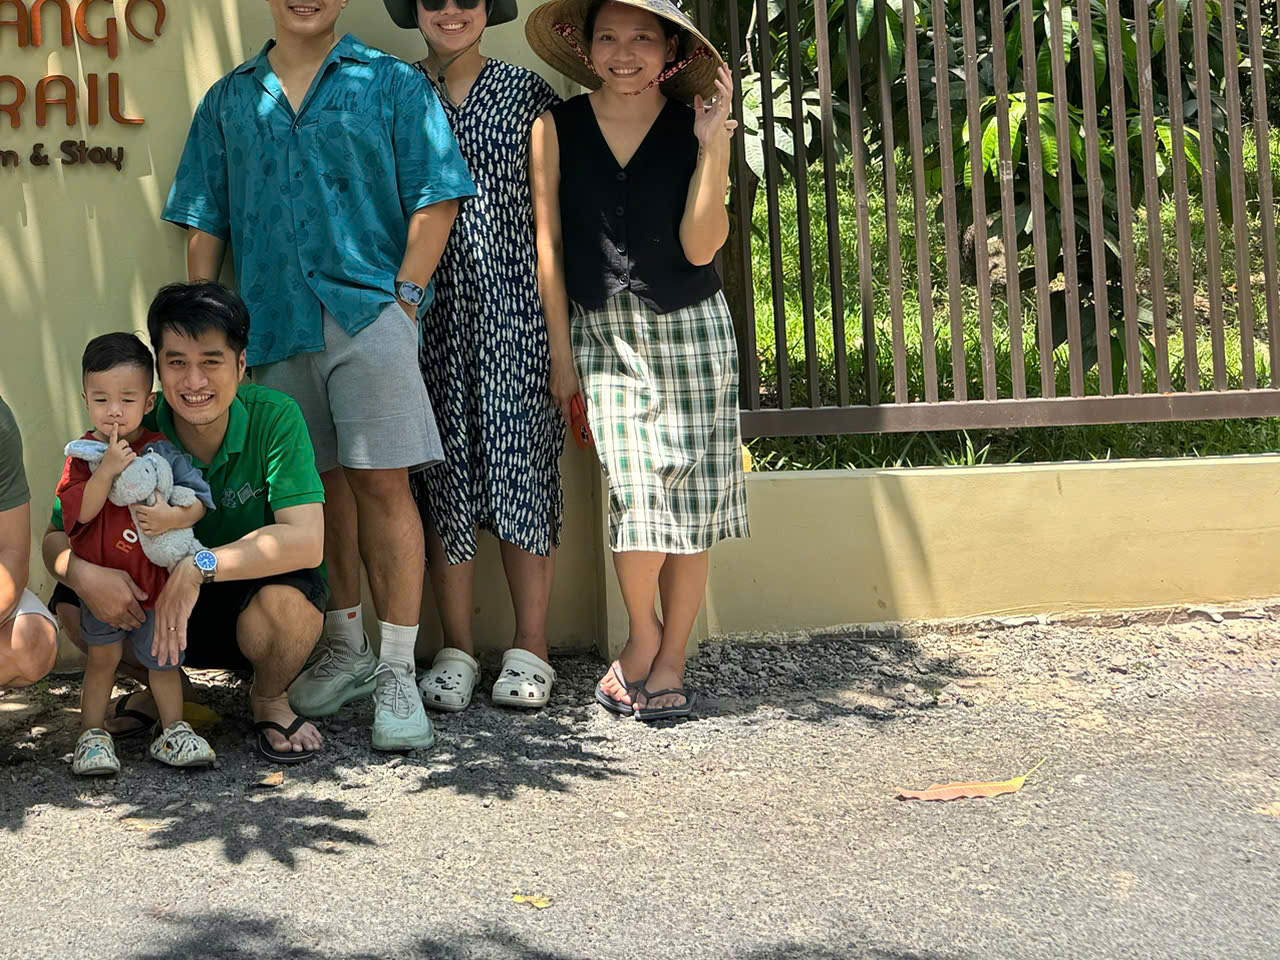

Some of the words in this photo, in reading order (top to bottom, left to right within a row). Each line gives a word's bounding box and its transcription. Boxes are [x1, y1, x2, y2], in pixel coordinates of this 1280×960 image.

[30, 143, 50, 166] &
[60, 140, 124, 172] Stay
[115, 525, 138, 553] RO
